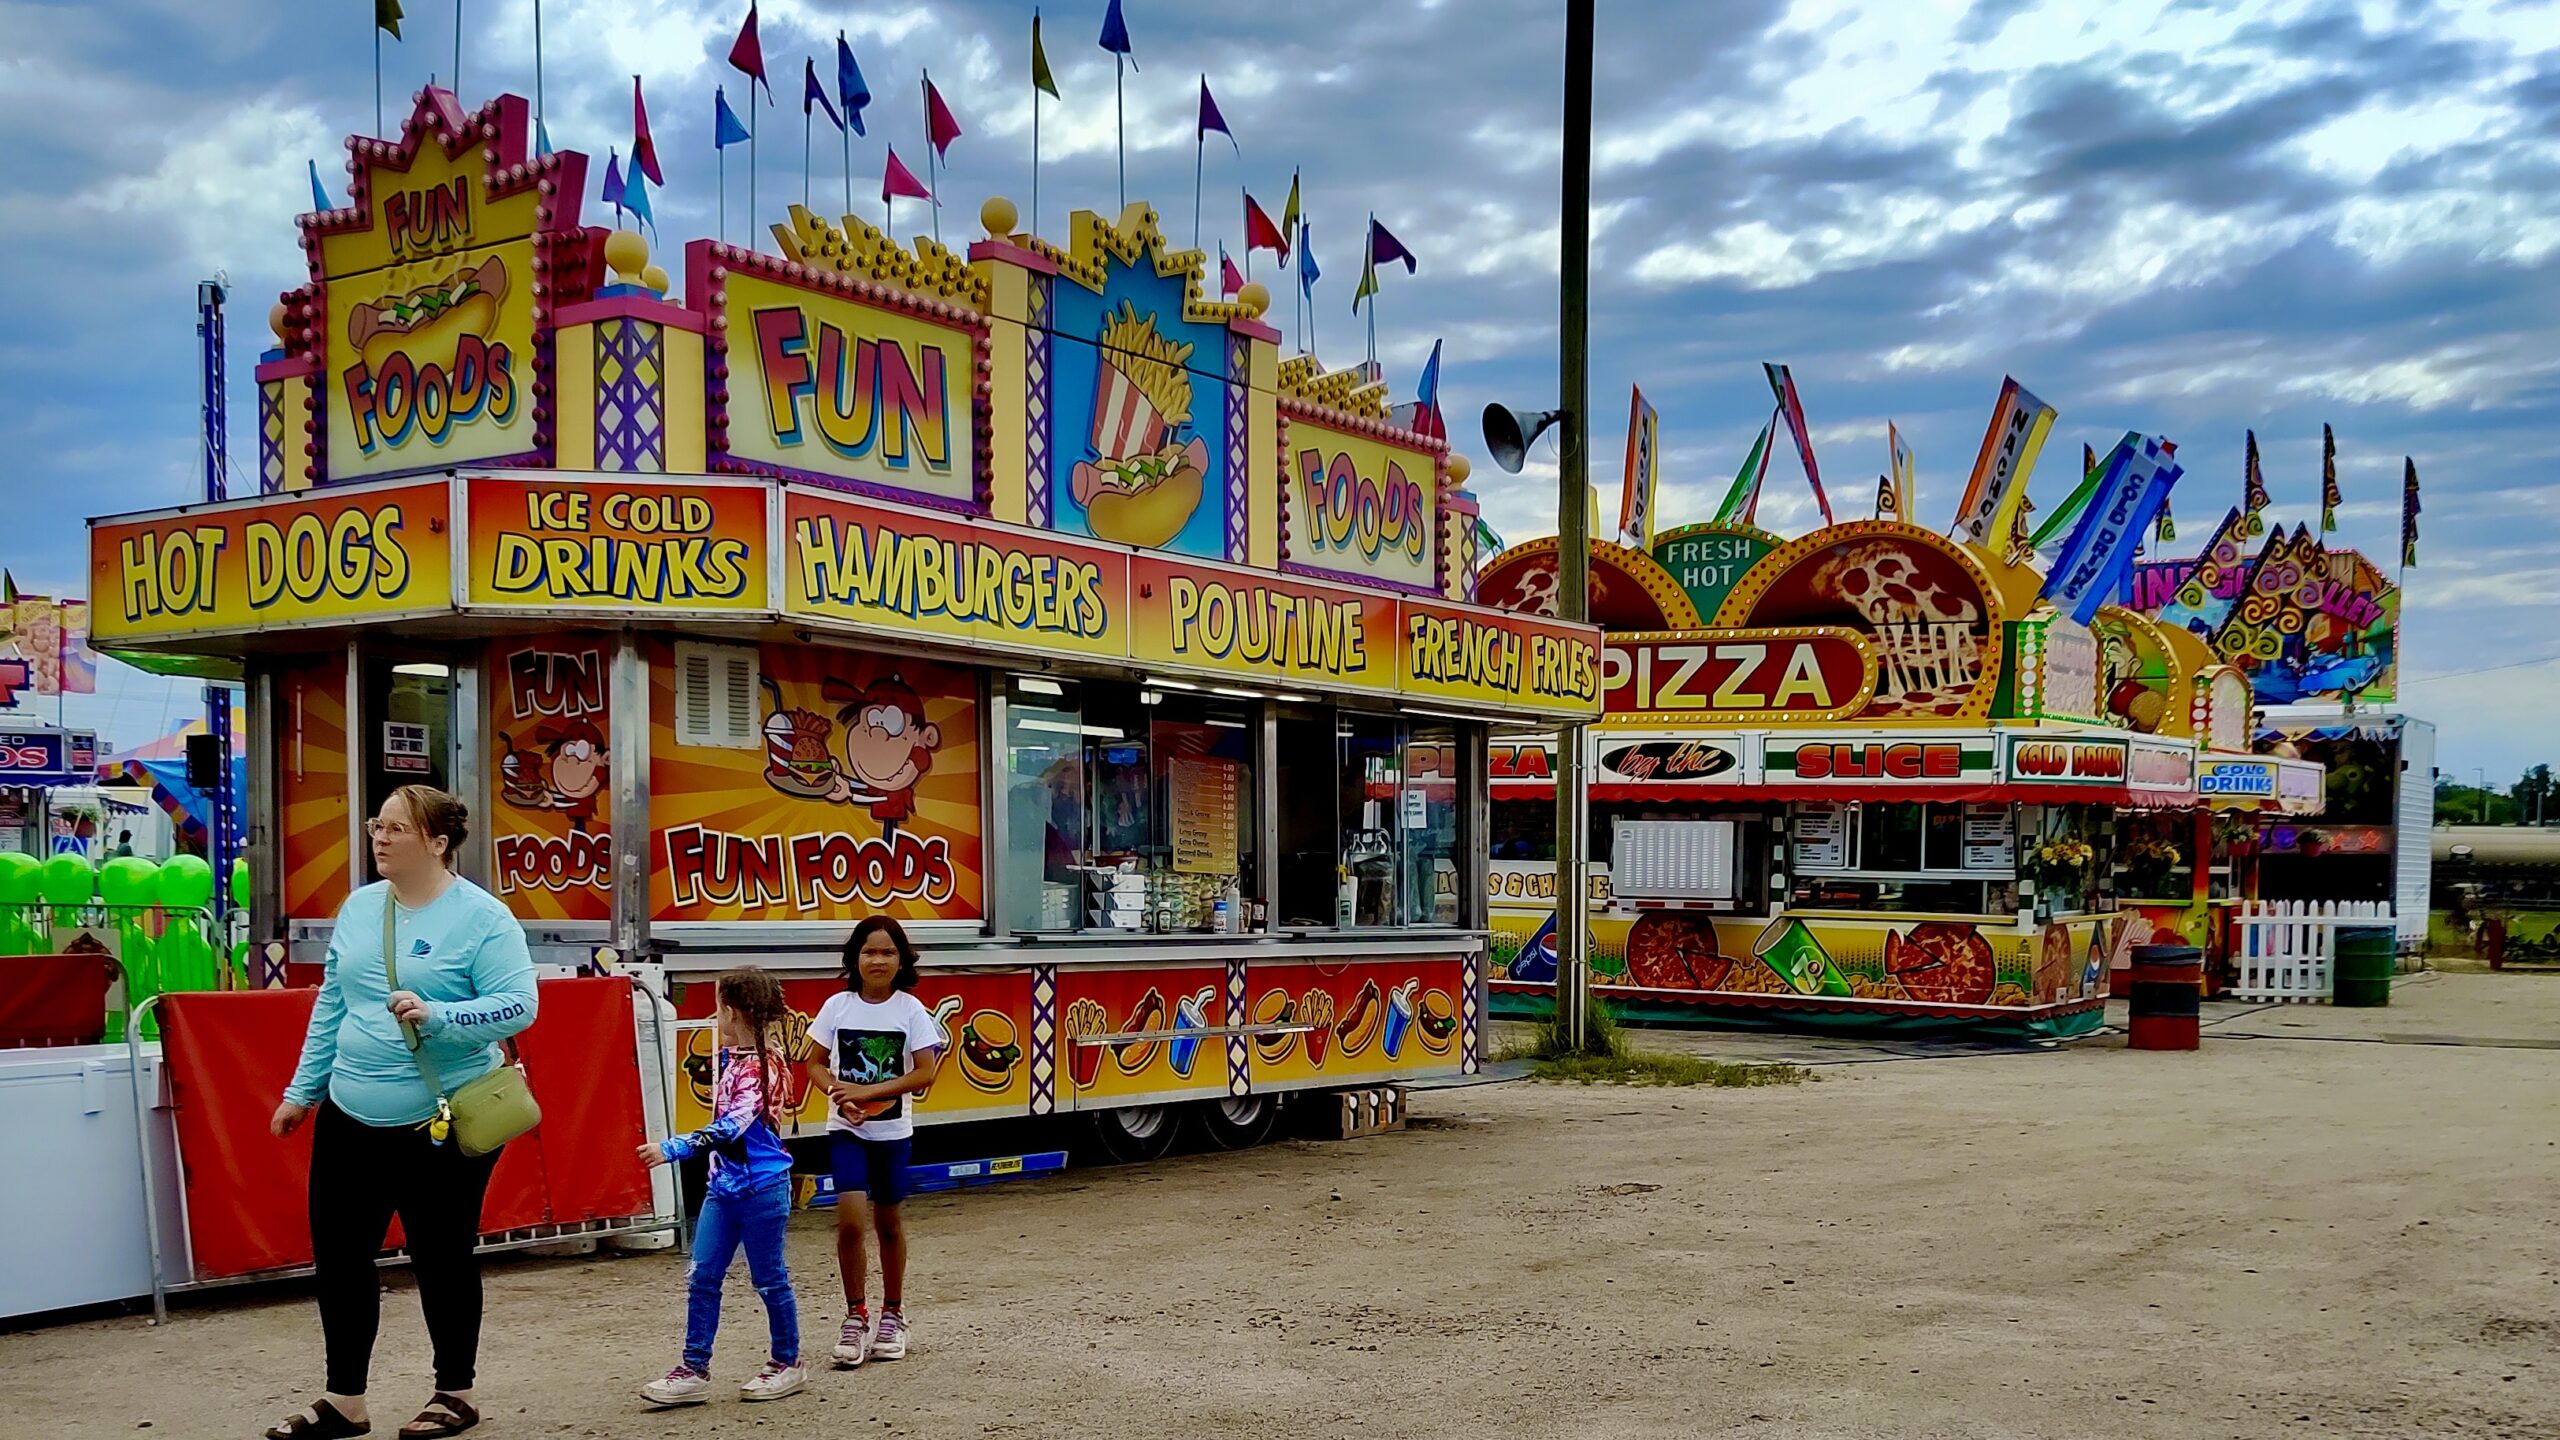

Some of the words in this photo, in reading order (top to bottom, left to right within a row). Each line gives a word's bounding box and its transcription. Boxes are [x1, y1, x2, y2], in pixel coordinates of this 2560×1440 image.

[383, 175, 470, 255] FUN
[343, 333, 513, 454] FOODS
[752, 306, 952, 468] FUN
[1299, 447, 1426, 557] FOODS
[1969, 407, 2030, 538] NACHOS
[2109, 473, 2145, 527] COLD
[527, 491, 590, 531] ICE
[602, 494, 712, 535] COLD
[121, 527, 226, 622] HOT
[245, 505, 412, 609] DOGS
[493, 532, 749, 602] DRINKS
[795, 516, 1108, 638] HAMBURGERS
[1667, 538, 1751, 564] FRESH
[1683, 564, 1735, 588] HOT
[1169, 576, 1367, 675] POUTINE
[1409, 613, 1521, 695] FRENCH
[1531, 631, 1596, 702] FRIES
[507, 647, 603, 718] FUN
[1603, 643, 1833, 710] PIZZA
[1408, 745, 1553, 779] PIZA
[1616, 743, 1660, 782] by
[1664, 739, 1722, 772] the
[1795, 741, 1962, 779] SLICE
[2016, 744, 2068, 776] COLD
[2199, 775, 2273, 795] DRINKS
[2212, 763, 2267, 777] COLD
[495, 829, 612, 894] FOODS
[665, 822, 787, 909] FUN
[793, 828, 956, 911] FOODS
[1505, 872, 1523, 898] &
[1515, 946, 1538, 976] pepsi
